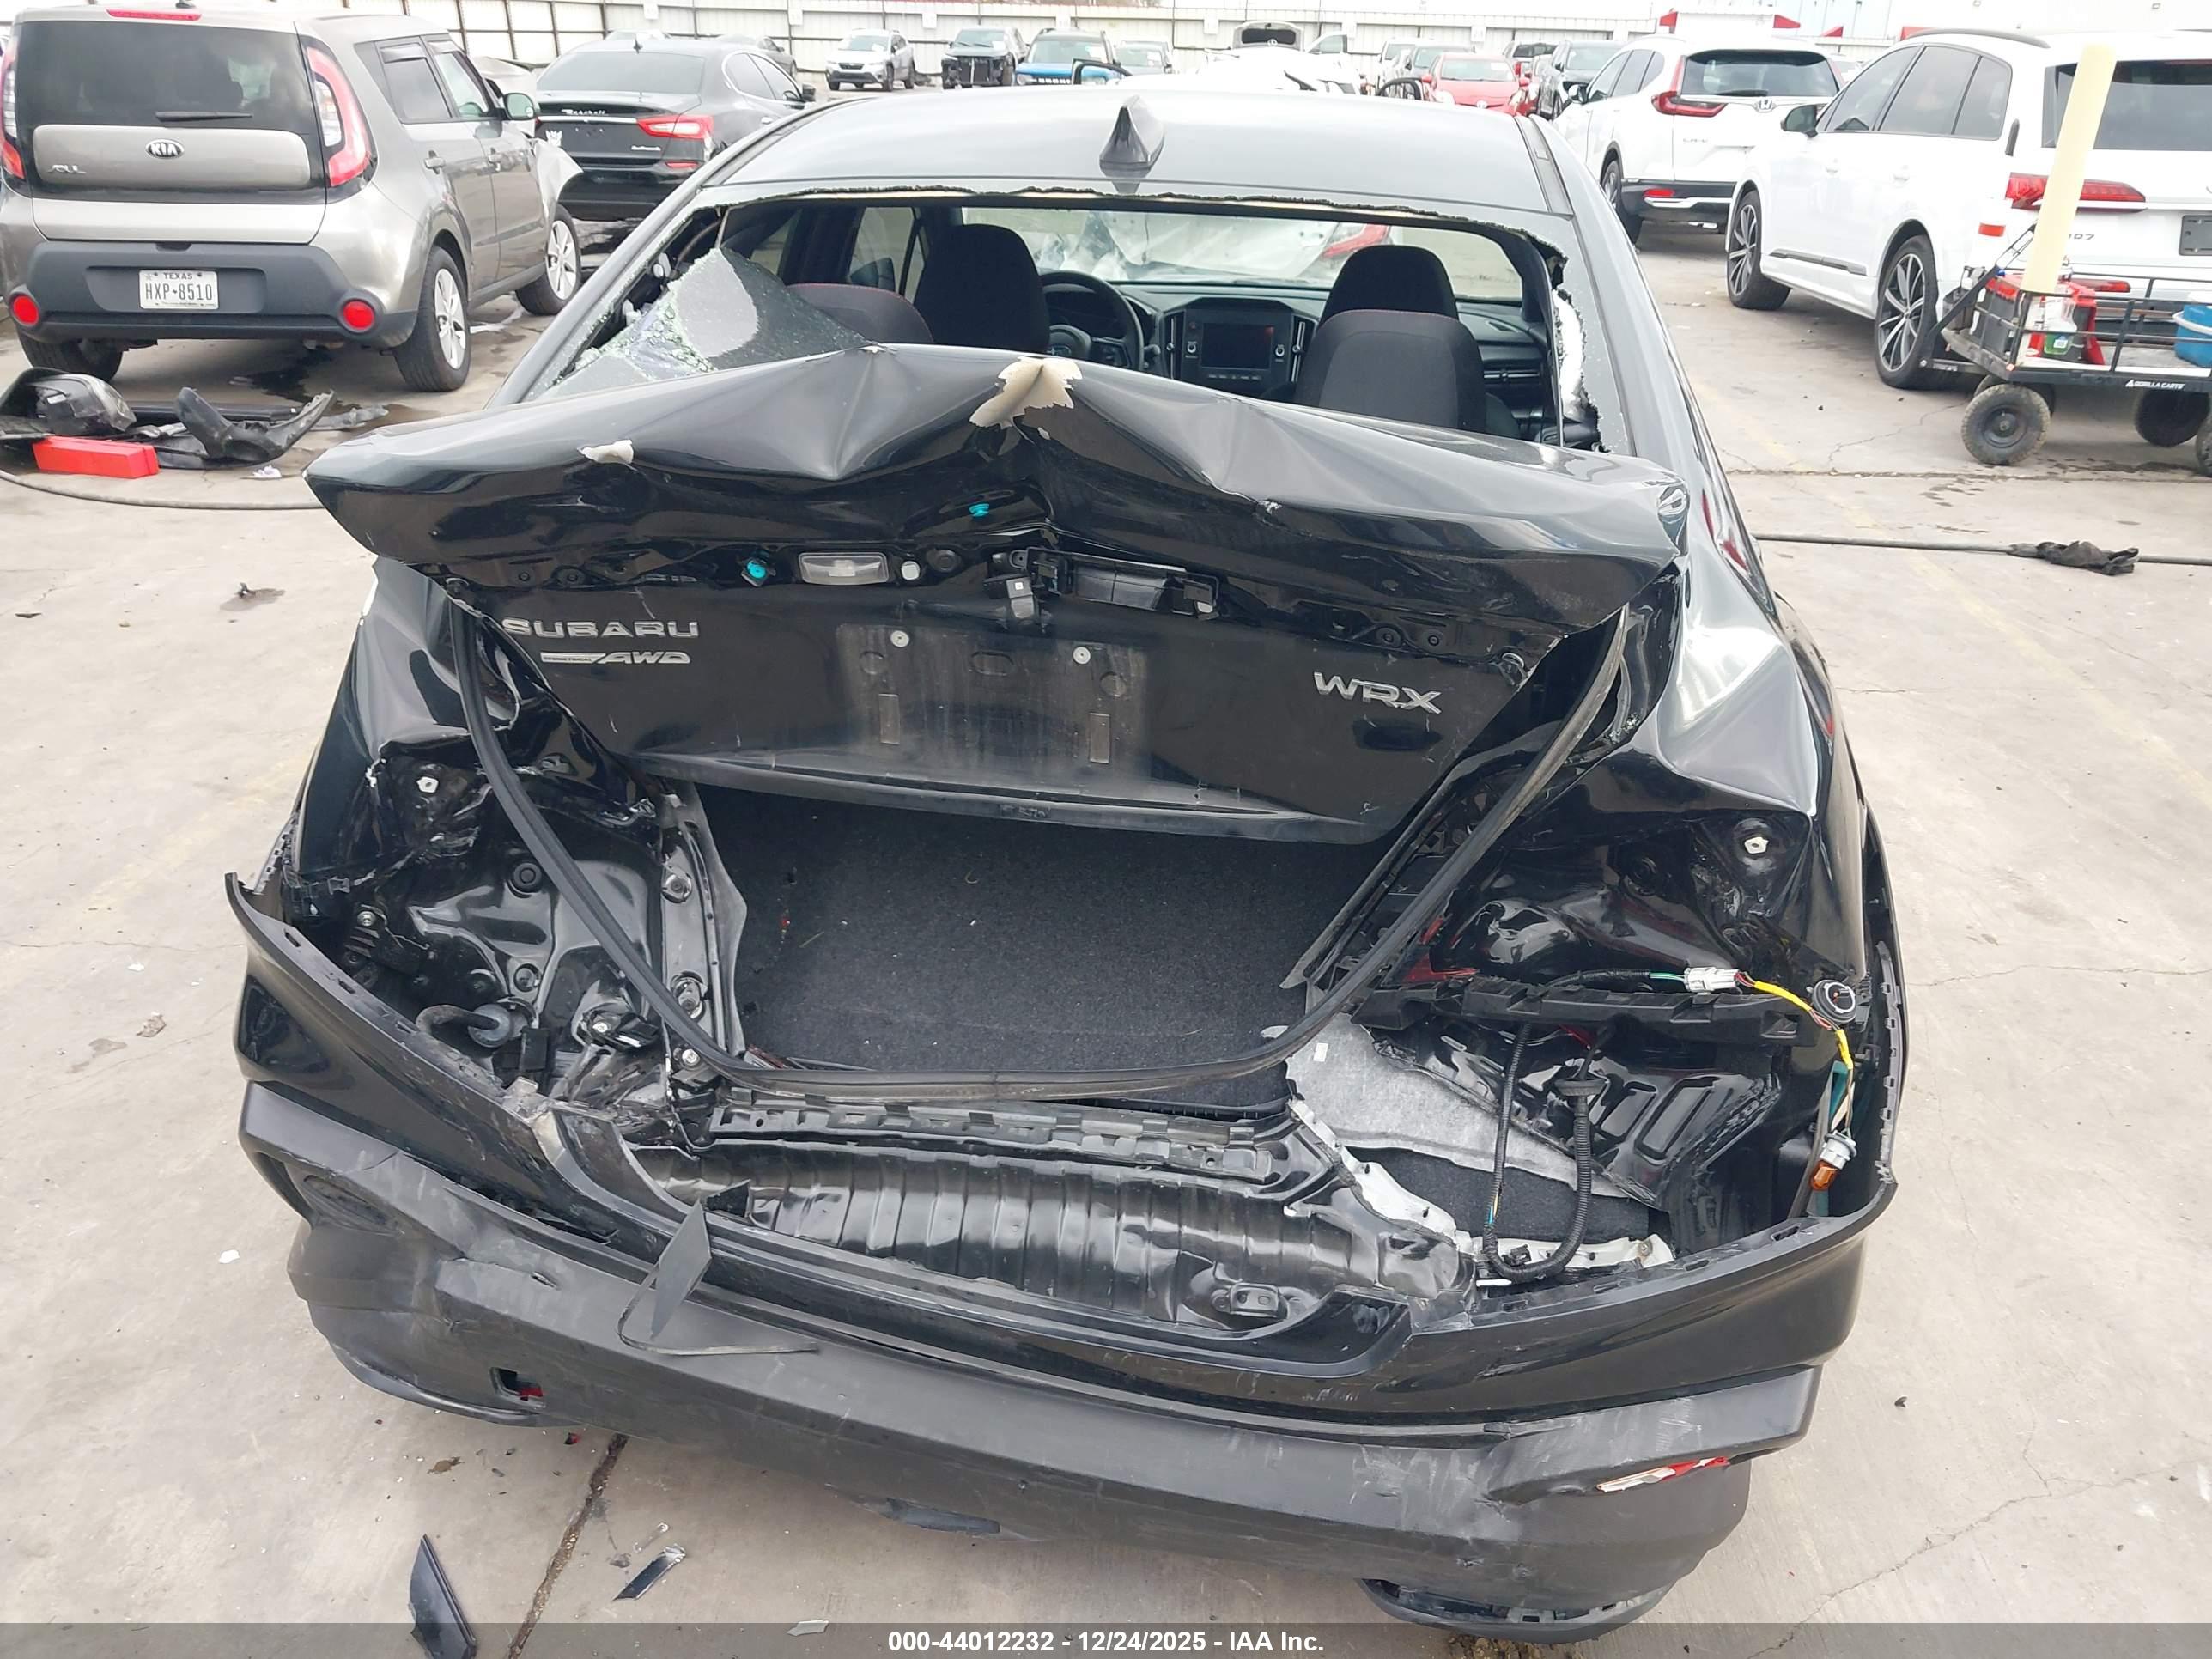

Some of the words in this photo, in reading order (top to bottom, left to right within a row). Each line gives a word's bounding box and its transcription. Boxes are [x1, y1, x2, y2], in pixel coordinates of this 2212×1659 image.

[150, 143, 179, 156] KIA
[501, 617, 699, 638] SUBARU
[598, 651, 691, 665] AWD
[1314, 672, 1442, 714] WRX
